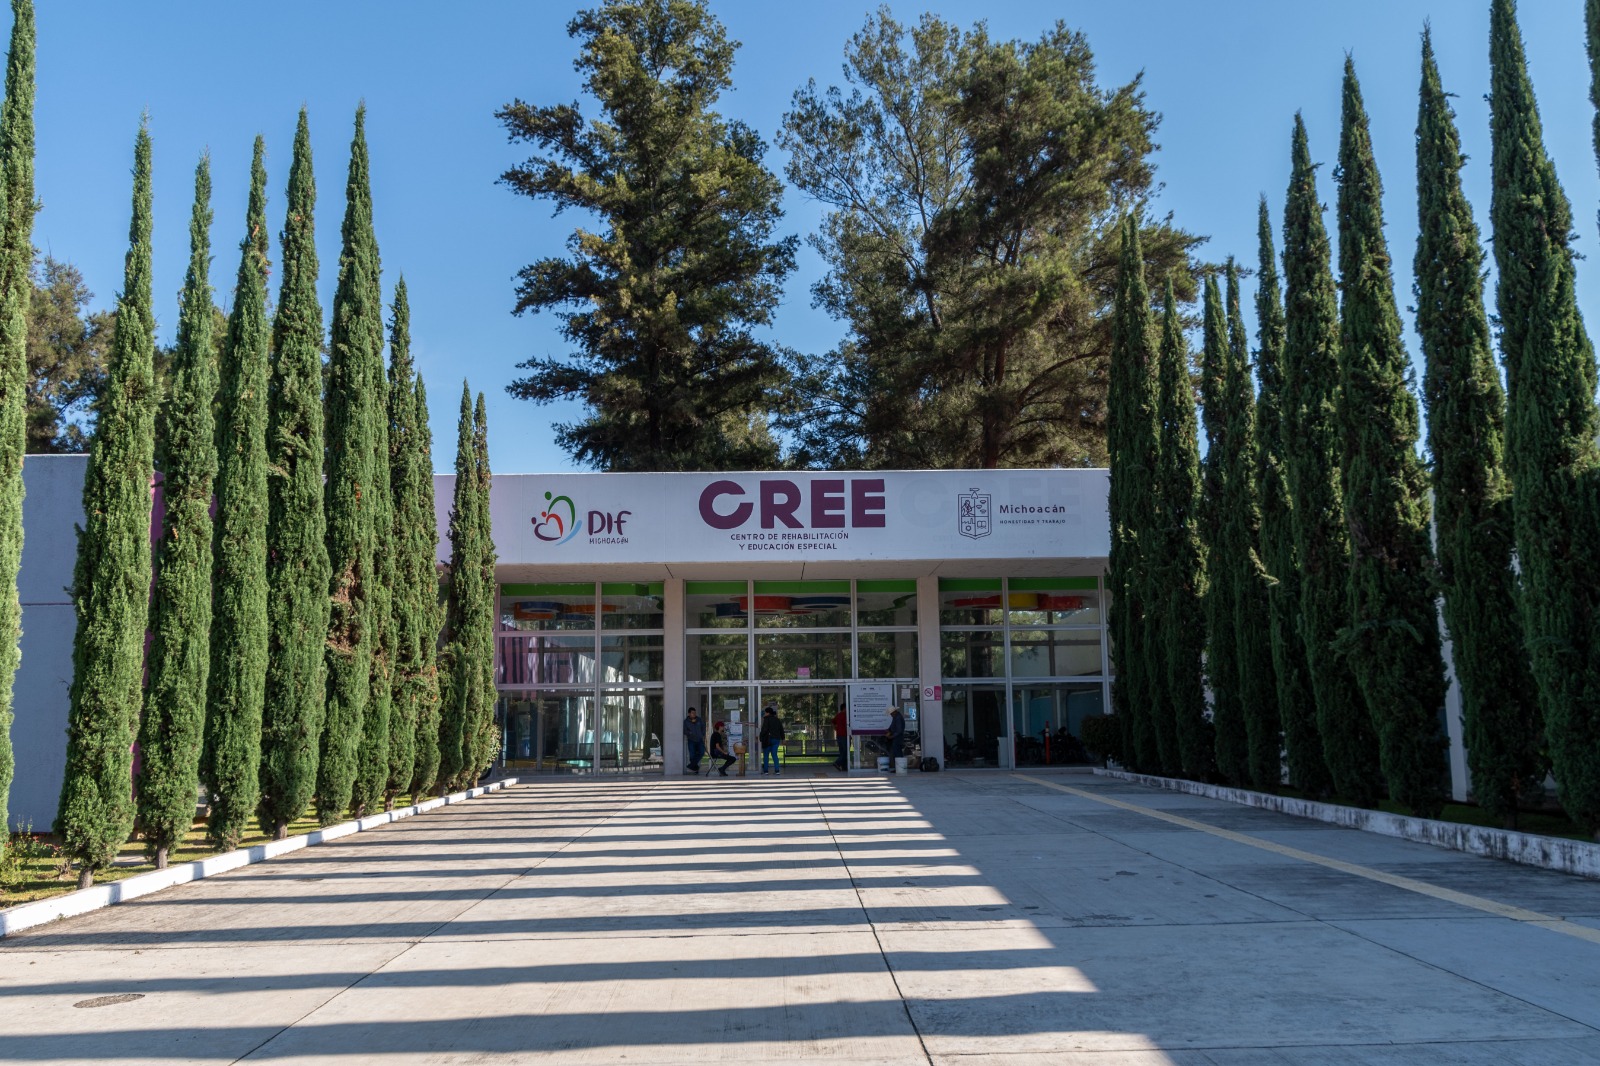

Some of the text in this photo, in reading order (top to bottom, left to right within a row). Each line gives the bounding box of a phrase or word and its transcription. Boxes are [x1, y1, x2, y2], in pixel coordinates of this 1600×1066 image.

[699, 479, 886, 529] CREE
[1000, 504, 1065, 514] Michoacán
[781, 530, 849, 540] REHABILITACIÓN
[747, 541, 795, 550] EDUCACIÓN
